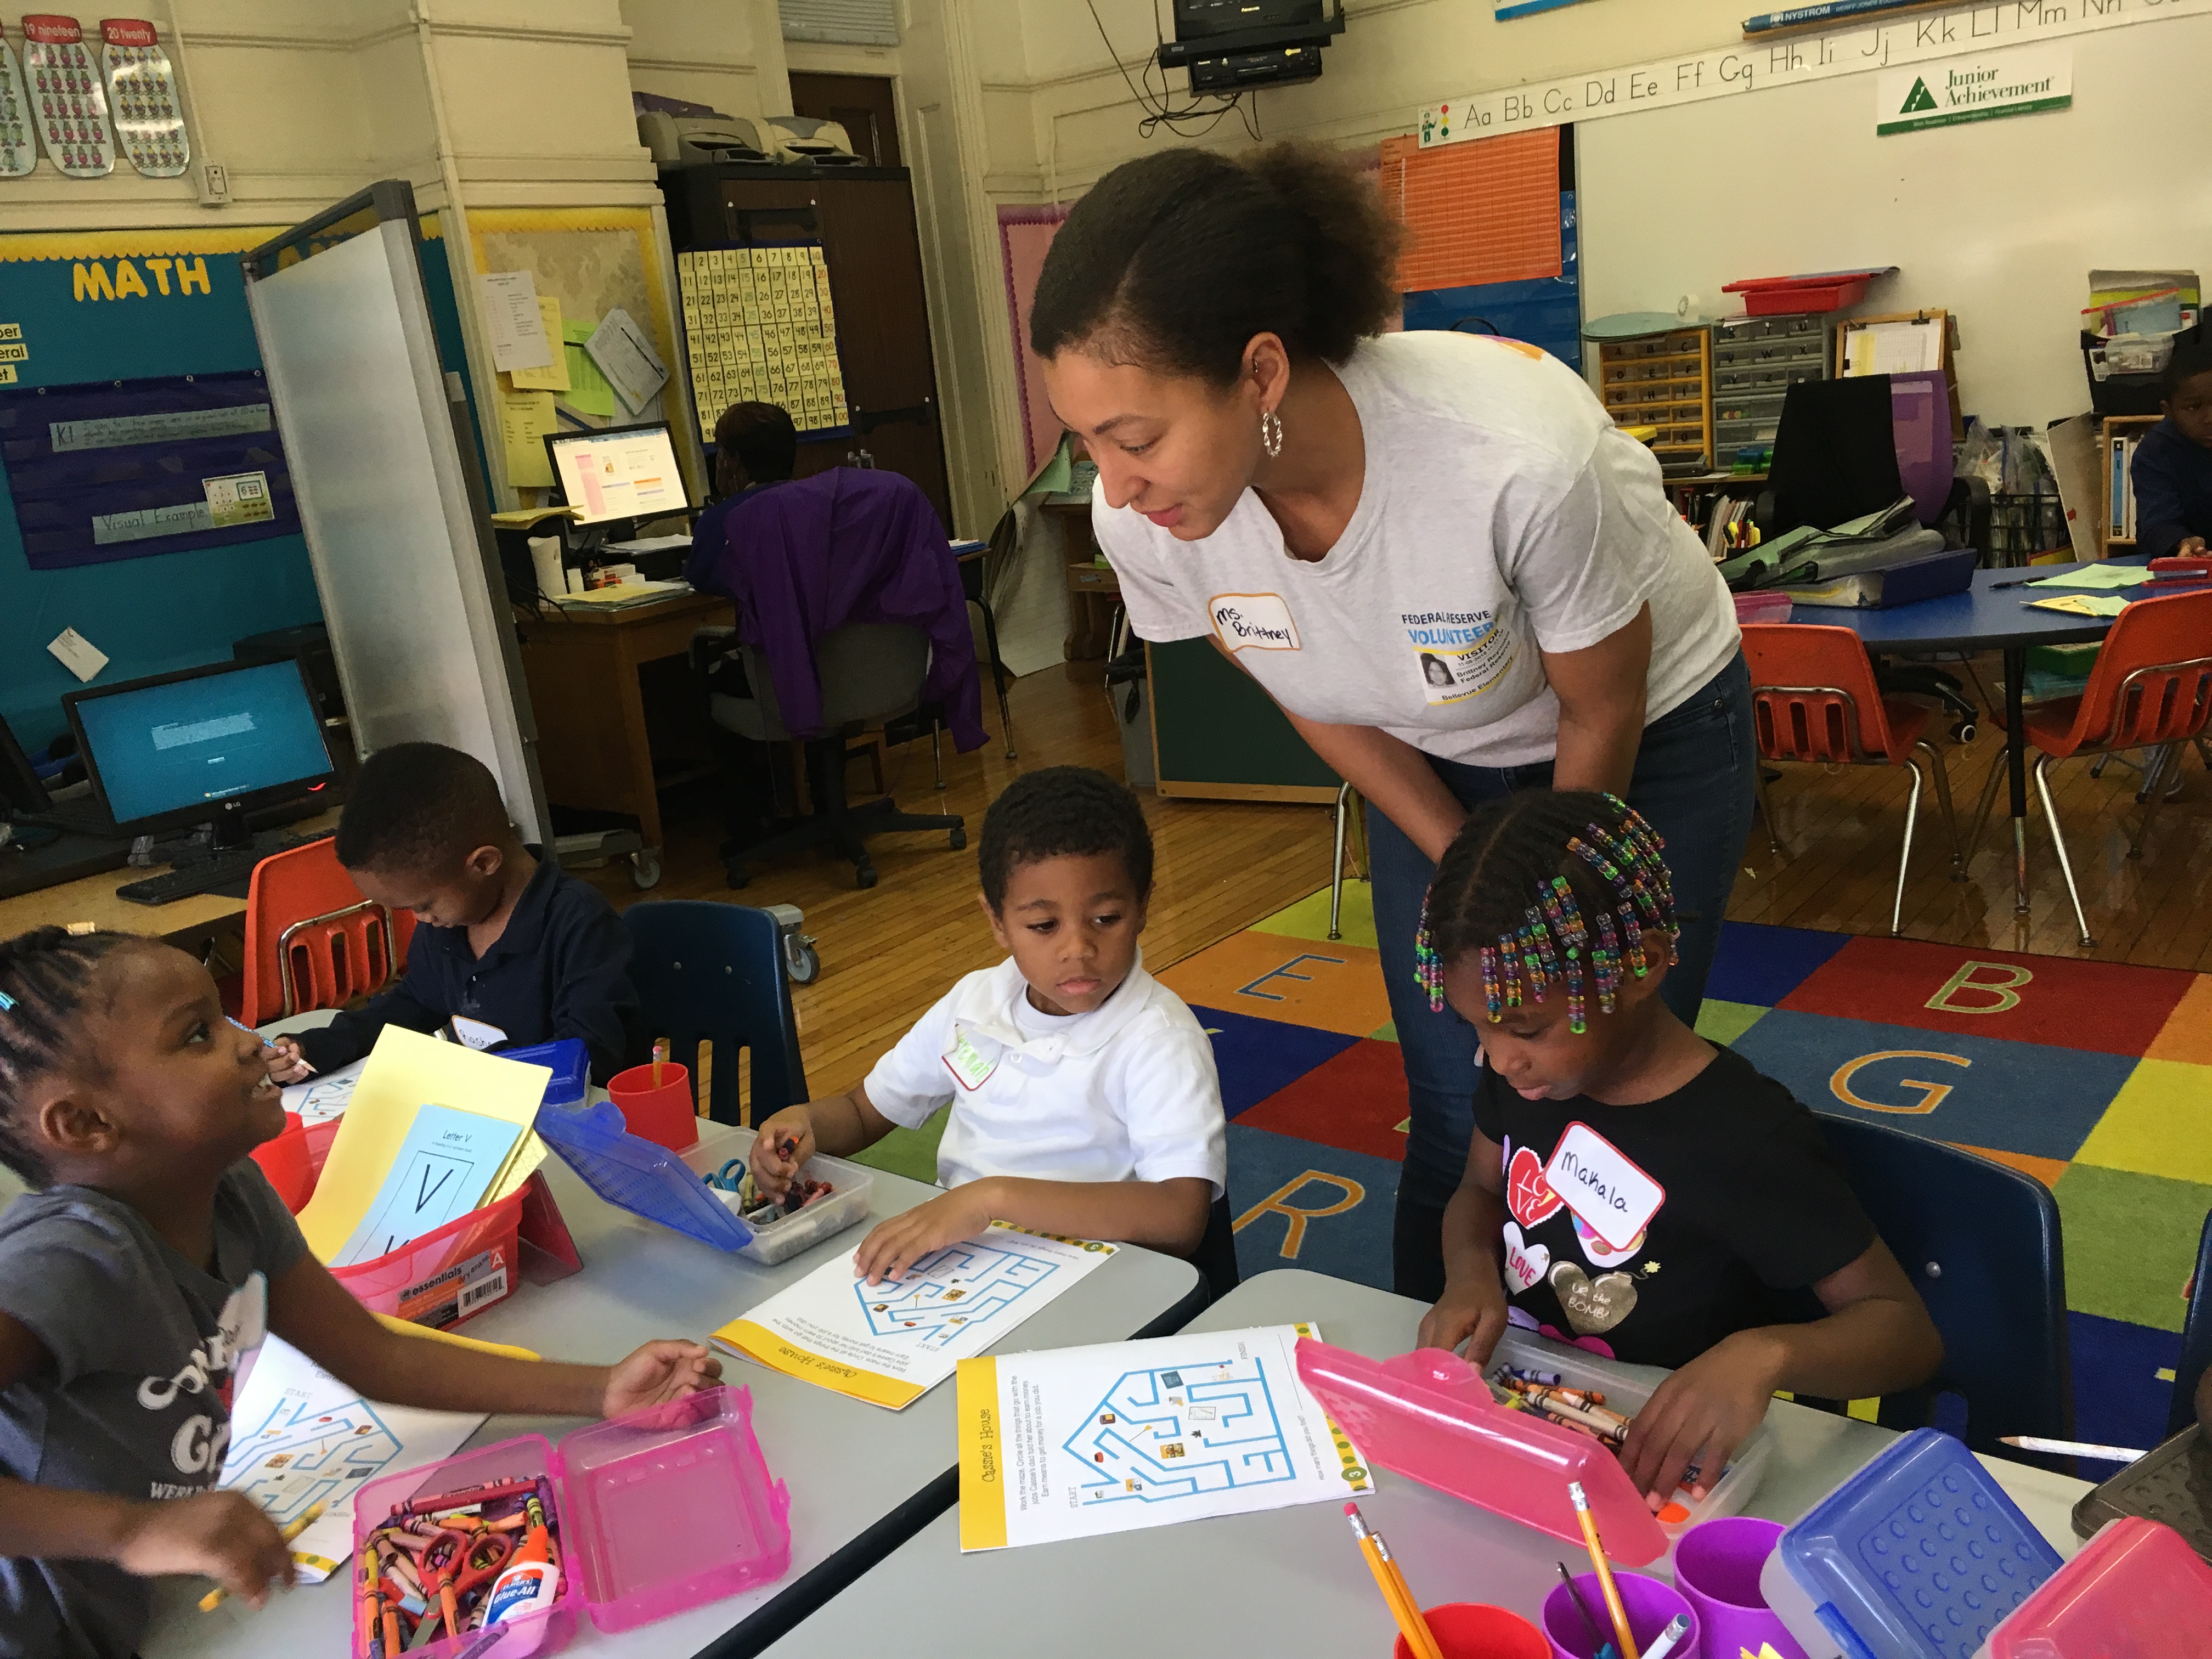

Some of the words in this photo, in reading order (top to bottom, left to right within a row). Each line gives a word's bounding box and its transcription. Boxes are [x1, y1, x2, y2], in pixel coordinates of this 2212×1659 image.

[1785, 5, 1830, 21] NYSTROM
[25, 22, 35, 34] 19
[38, 25, 81, 37] nineteen
[108, 27, 119, 39] 20
[120, 27, 151, 42] twenty
[1464, 104, 1491, 129] Aa
[1505, 95, 1532, 122] Bb
[1544, 89, 1573, 114] Cc
[1586, 78, 1615, 107] Dd
[1630, 72, 1657, 99] Ee
[1677, 61, 1704, 91] Ff
[1719, 55, 1753, 89] Gg
[1770, 44, 1802, 74] Hh
[1819, 38, 1833, 65] Ii
[1861, 28, 1889, 66] Jj
[1917, 20, 1955, 47] Kk
[1972, 6, 1999, 37] Ll
[2017, 0, 2066, 29] Mm
[1945, 66, 1999, 89] Junior
[1945, 77, 2052, 108] Achievement
[699, 257, 703, 266] 2
[713, 256, 718, 265] 3
[727, 254, 732, 263] 4
[757, 253, 761, 262] 6
[772, 253, 776, 261] 7
[787, 252, 791, 261] 8
[800, 252, 805, 260] 9
[72, 257, 211, 302] MATH
[684, 276, 692, 286] 11
[699, 276, 708, 285] 12
[714, 275, 722, 284] 13
[728, 274, 736, 283] 14
[757, 273, 766, 281] 16
[772, 272, 781, 281] 17
[788, 271, 796, 280] 18
[803, 270, 810, 279] 19
[818, 269, 826, 278] 20
[1615, 348, 1622, 356] A
[1646, 345, 1654, 353] B
[1681, 343, 1688, 352] C
[1727, 354, 1734, 363] V
[1762, 350, 1773, 359] W
[1617, 371, 1624, 379] D
[1649, 369, 1655, 377] E
[1686, 365, 1692, 373] F
[1765, 374, 1772, 382] Z
[1616, 393, 1623, 402] G
[1649, 391, 1655, 399] H
[102, 511, 145, 531] Visual
[154, 503, 206, 529] Example
[1402, 612, 1447, 624] FEDERAL
[1447, 610, 1491, 624] RESERVE
[1232, 621, 1293, 647] Brittney
[1457, 628, 1503, 661] VISITOR
[1460, 669, 1489, 684] Federal
[1489, 640, 1510, 668] Reserve
[1442, 688, 1476, 701] Bellevue
[1477, 656, 1513, 690] Elementary
[1457, 663, 1486, 678] Brittney
[1234, 953, 1347, 1001] E
[1923, 960, 2033, 1014] B
[1830, 1049, 1972, 1115] G
[443, 1130, 462, 1142] Letter
[465, 1134, 472, 1143] V
[415, 1164, 454, 1214] V
[1231, 1169, 1365, 1260] R
[1510, 1246, 1537, 1287] LOVE
[412, 1265, 463, 1296] essentials
[1593, 1292, 1612, 1305] the
[1568, 1296, 1610, 1321] BOMB!
[916, 1342, 941, 1352] START
[1237, 1341, 1248, 1360] FINISH
[778, 1346, 815, 1365] House
[816, 1361, 857, 1378] Cassie's
[284, 1387, 313, 1400] START
[1035, 1406, 1043, 1415] job
[980, 1408, 994, 1440] House
[1014, 1418, 1023, 1432] things
[1302, 1425, 1311, 1435] you
[1039, 1446, 1047, 1455] get
[1307, 1442, 1318, 1456] things
[980, 1444, 995, 1482] Cassie's
[1016, 1450, 1024, 1466] Circle
[1312, 1455, 1322, 1469] many
[1029, 1468, 1037, 1491] Cassie's
[1316, 1470, 1324, 1481] How
[1031, 1492, 1040, 1504] jobs
[1041, 1483, 1049, 1497] Earn
[1068, 1486, 1077, 1508] START
[1019, 1496, 1028, 1510] Work
[503, 1579, 531, 1589] ELMER'S
[494, 1585, 536, 1604] Glue-All
